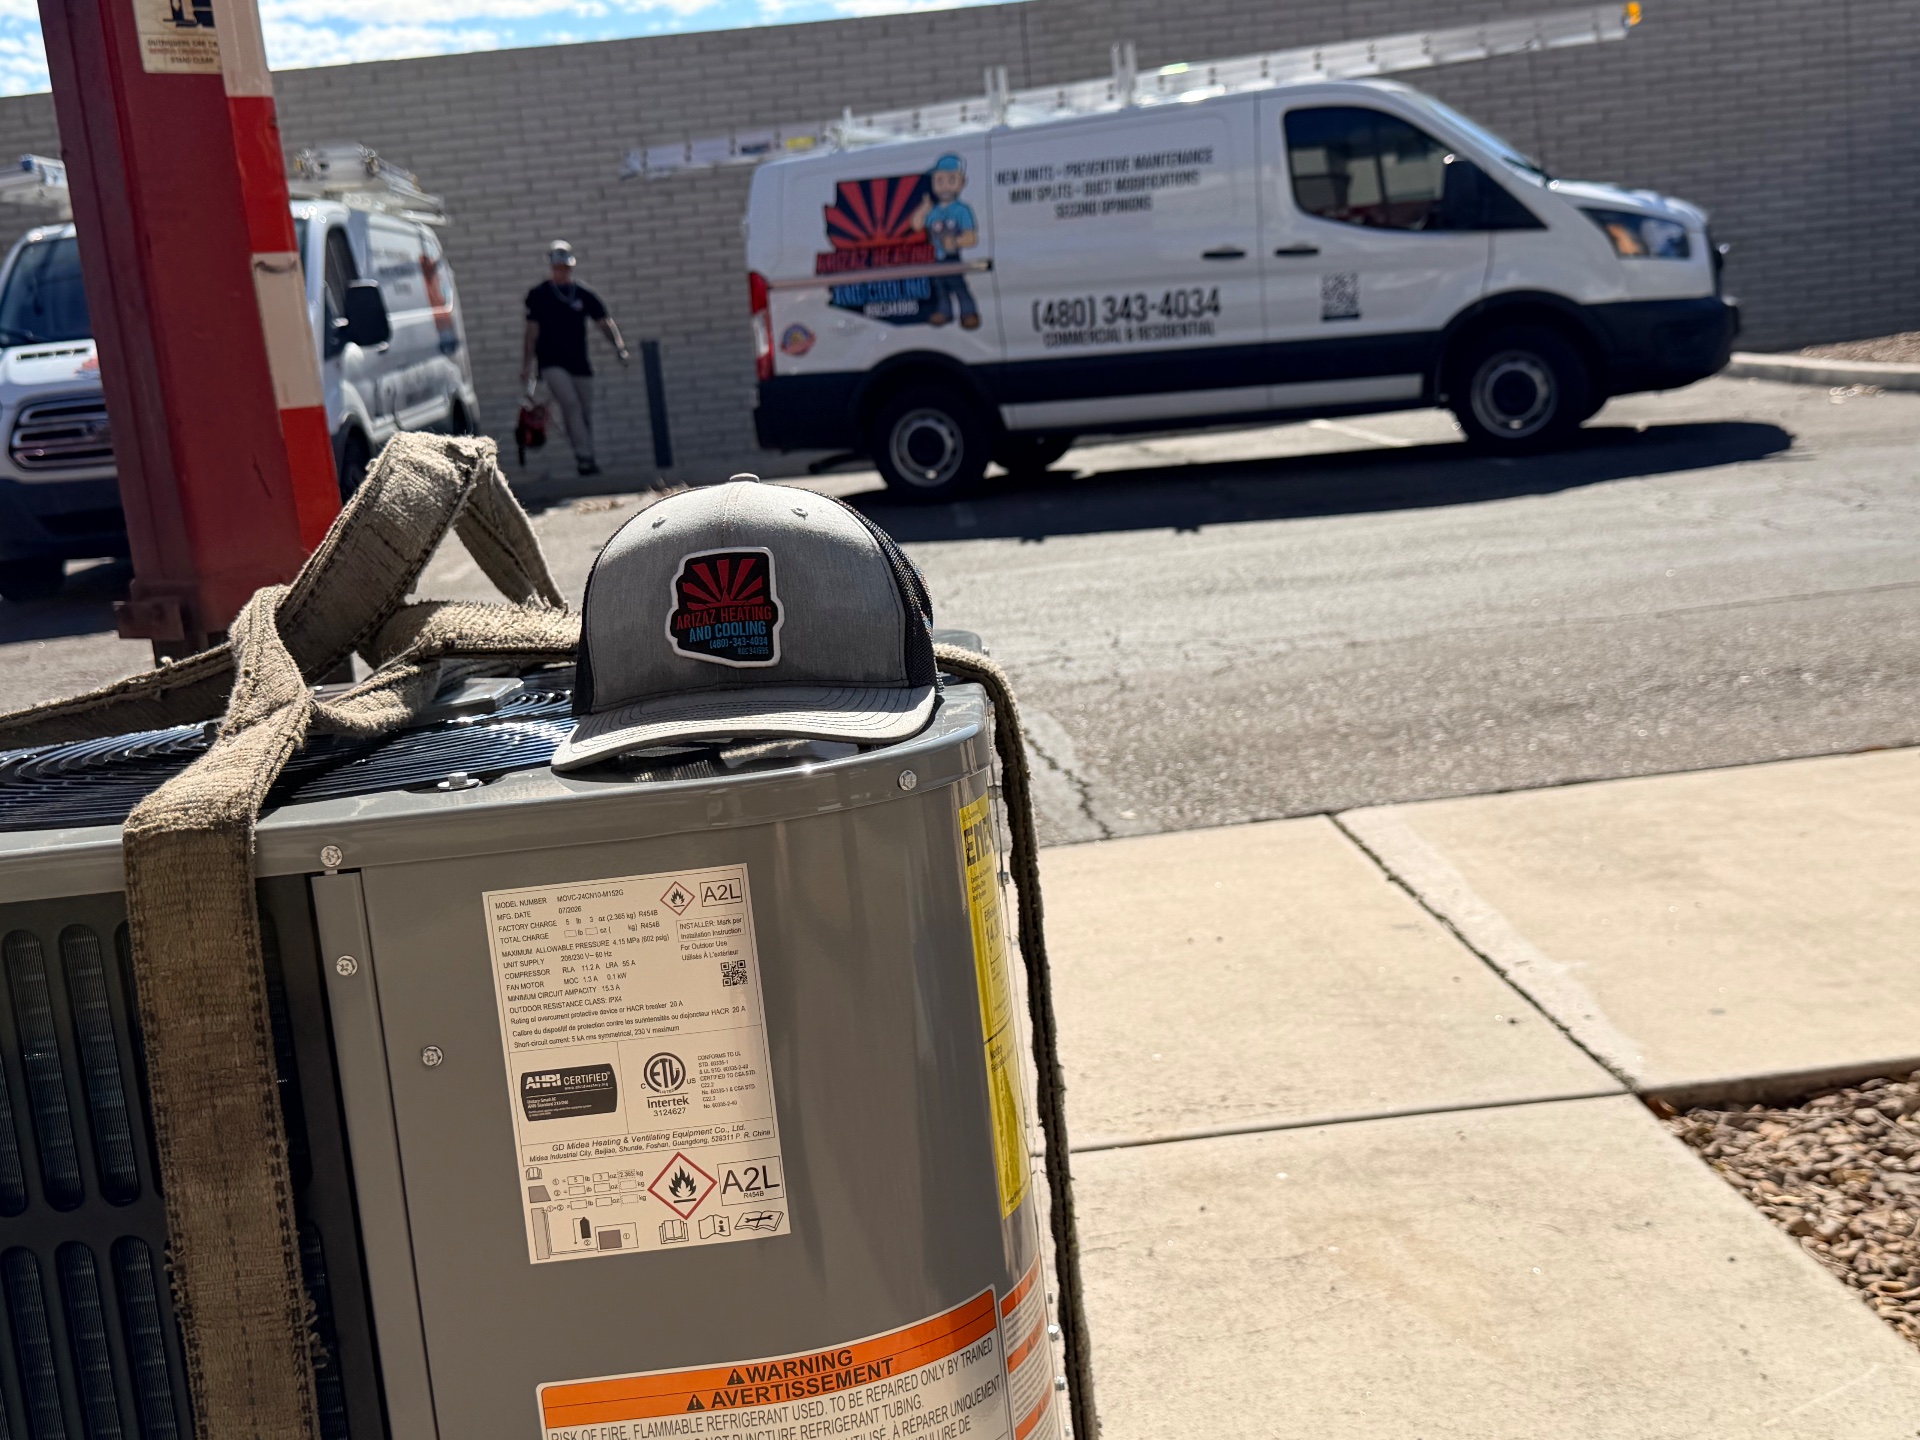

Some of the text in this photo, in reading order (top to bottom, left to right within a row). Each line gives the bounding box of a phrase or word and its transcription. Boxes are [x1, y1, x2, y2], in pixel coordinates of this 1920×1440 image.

[1032, 287, 1220, 332] (480) 343-4034
[676, 606, 772, 630] ARIZAZ HEATING
[689, 620, 766, 642] AND COOLING
[710, 636, 768, 650] (480)-343-4034
[519, 898, 547, 906] NUMBER
[702, 883, 741, 902] A2L
[498, 909, 658, 932] FACTORY CHARGE R454B
[680, 920, 715, 929] INSTALLER:
[522, 933, 549, 941] CHARGE
[712, 927, 741, 935] Instruction
[502, 949, 533, 957] MAXIMUM
[535, 944, 574, 953] ALLOWABLE
[575, 940, 610, 949] PRESSURE
[692, 941, 714, 949] Outdoor
[520, 958, 545, 966] SUPPLY
[505, 969, 550, 979] COMPRESSOR
[508, 993, 536, 1002] MINIMUM
[538, 990, 563, 998] CIRCUIT
[564, 986, 597, 995] AMPACITY
[509, 1005, 541, 1013] OUTDOOR
[543, 1000, 583, 1010] RESISTANCE
[584, 997, 607, 1005] CLASS:
[511, 1017, 529, 1025] Rating
[538, 1013, 569, 1021] overcurrent
[571, 1009, 598, 1019] protective
[599, 1007, 617, 1015] device
[626, 1004, 643, 1012] HACR
[645, 1002, 666, 1010] breaker
[512, 1029, 532, 1037] Calibre
[577, 1021, 605, 1031] protection
[652, 1025, 679, 1033] maximum
[648, 1056, 681, 1089] ETL
[647, 1095, 689, 1108] Intertek
[653, 1107, 686, 1116] 3124627
[550, 1151, 577, 1159] Industrial
[594, 1147, 616, 1155] Beijiao,
[618, 1144, 644, 1152] Shunde,
[646, 1141, 670, 1149] Foshan,
[672, 1137, 709, 1147] Guangdong,
[711, 1134, 733, 1142] 528311
[566, 1141, 590, 1149] Midea
[591, 1138, 621, 1148] Heating
[631, 1132, 670, 1143] Ventilating
[672, 1127, 712, 1139] Equipment
[714, 1125, 729, 1134] Co.,
[719, 1164, 780, 1194] A2L
[746, 1350, 853, 1384] WARNING
[582, 1429, 597, 1440] OF
[634, 1416, 704, 1440] FLAMMABLE
[706, 1406, 790, 1432] REFRIGERANT
[792, 1400, 828, 1420] USED.
[830, 1396, 846, 1413] TO
[849, 1391, 864, 1409] BE
[866, 1374, 918, 1404] REPAIRED
[920, 1363, 945, 1386] ONLY
[947, 1356, 959, 1375] BY
[960, 1337, 992, 1368] TRAINED
[711, 1358, 894, 1408] AVERTISSEMENT
[902, 1405, 948, 1437] RÉPARER
[950, 1374, 1000, 1416] UNIQUEMENT
[800, 1407, 880, 1440] REFRIGERANT
[882, 1394, 924, 1420] TUBING.
[958, 1415, 972, 1434] DE
